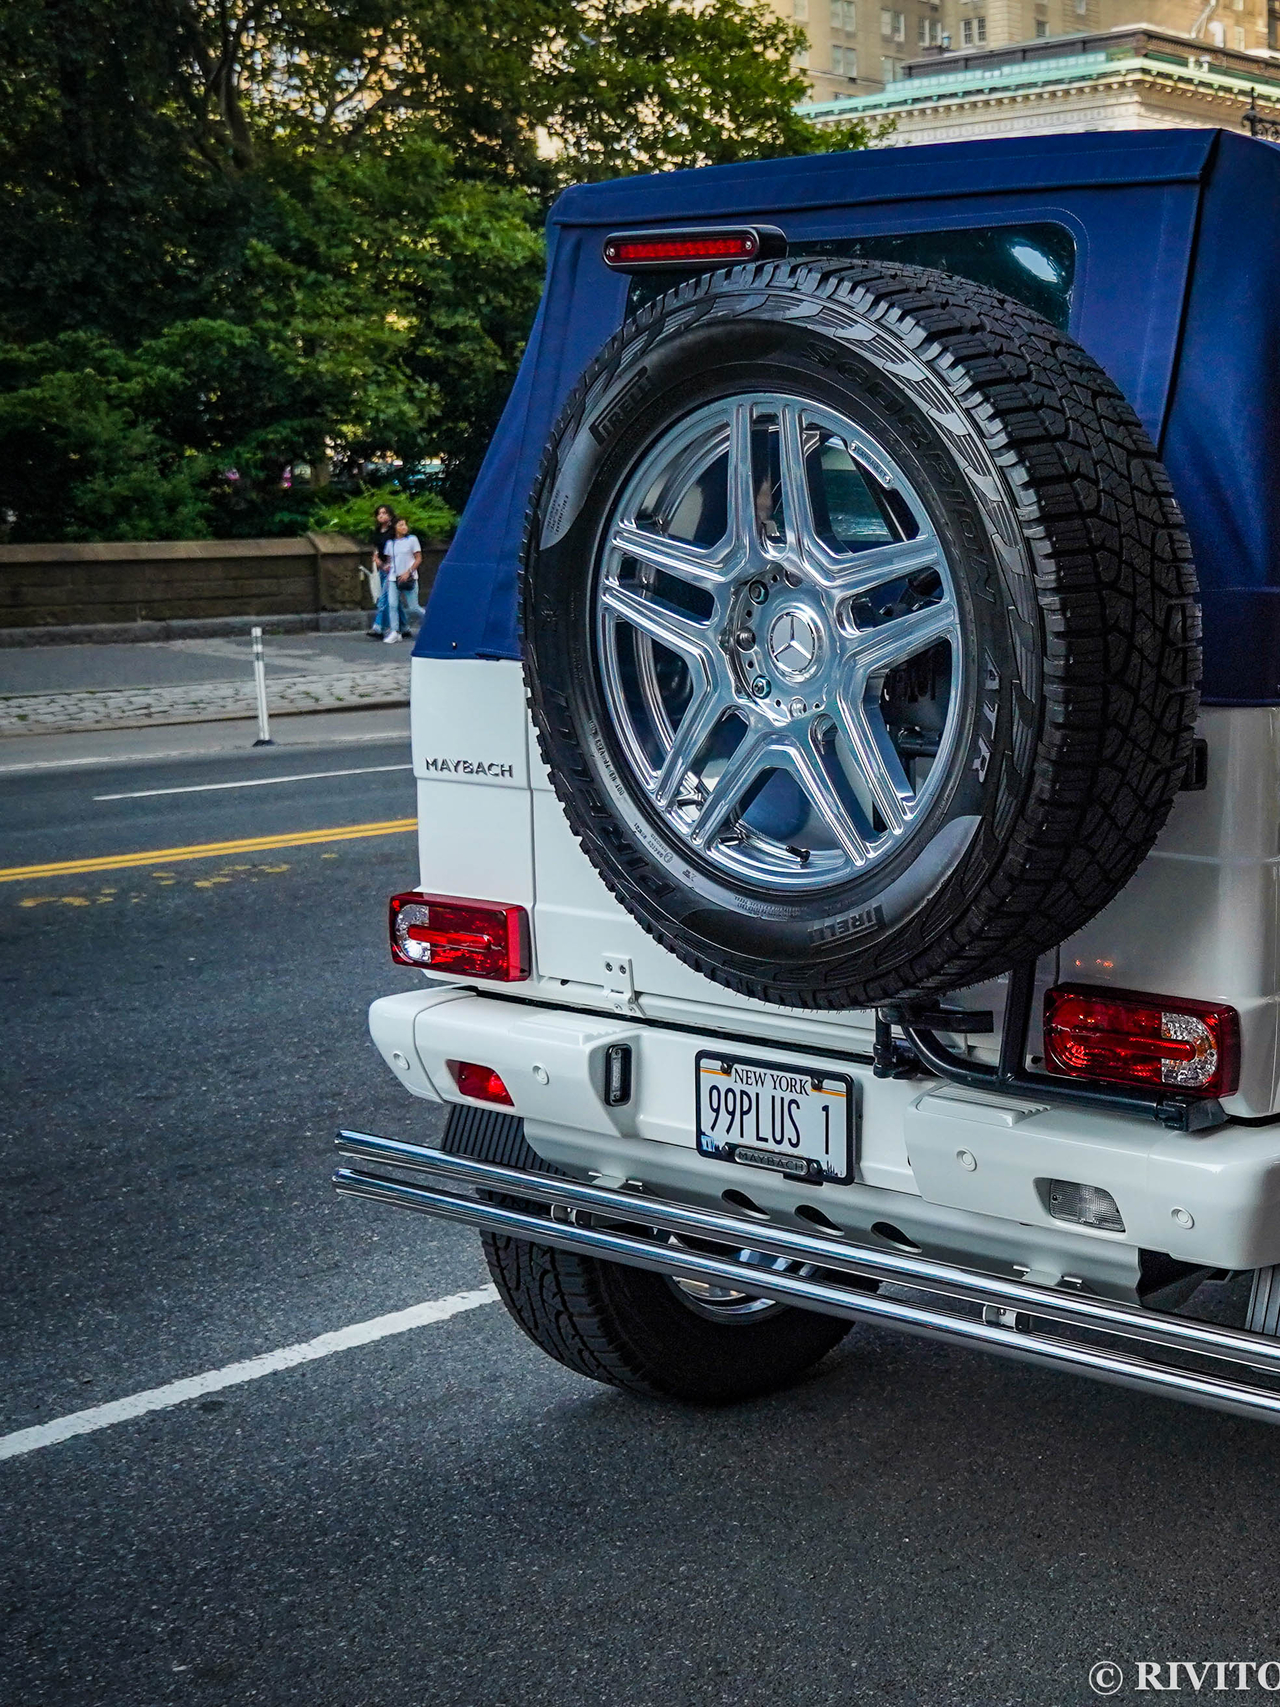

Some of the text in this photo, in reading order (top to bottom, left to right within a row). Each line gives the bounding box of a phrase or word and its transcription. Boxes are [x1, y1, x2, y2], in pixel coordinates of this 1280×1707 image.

[425, 757, 514, 778] MAYBACH
[733, 1067, 811, 1097] NEW YORK
[708, 1084, 830, 1156] 99PLUS 1
[737, 1150, 805, 1173] MAYBACH
